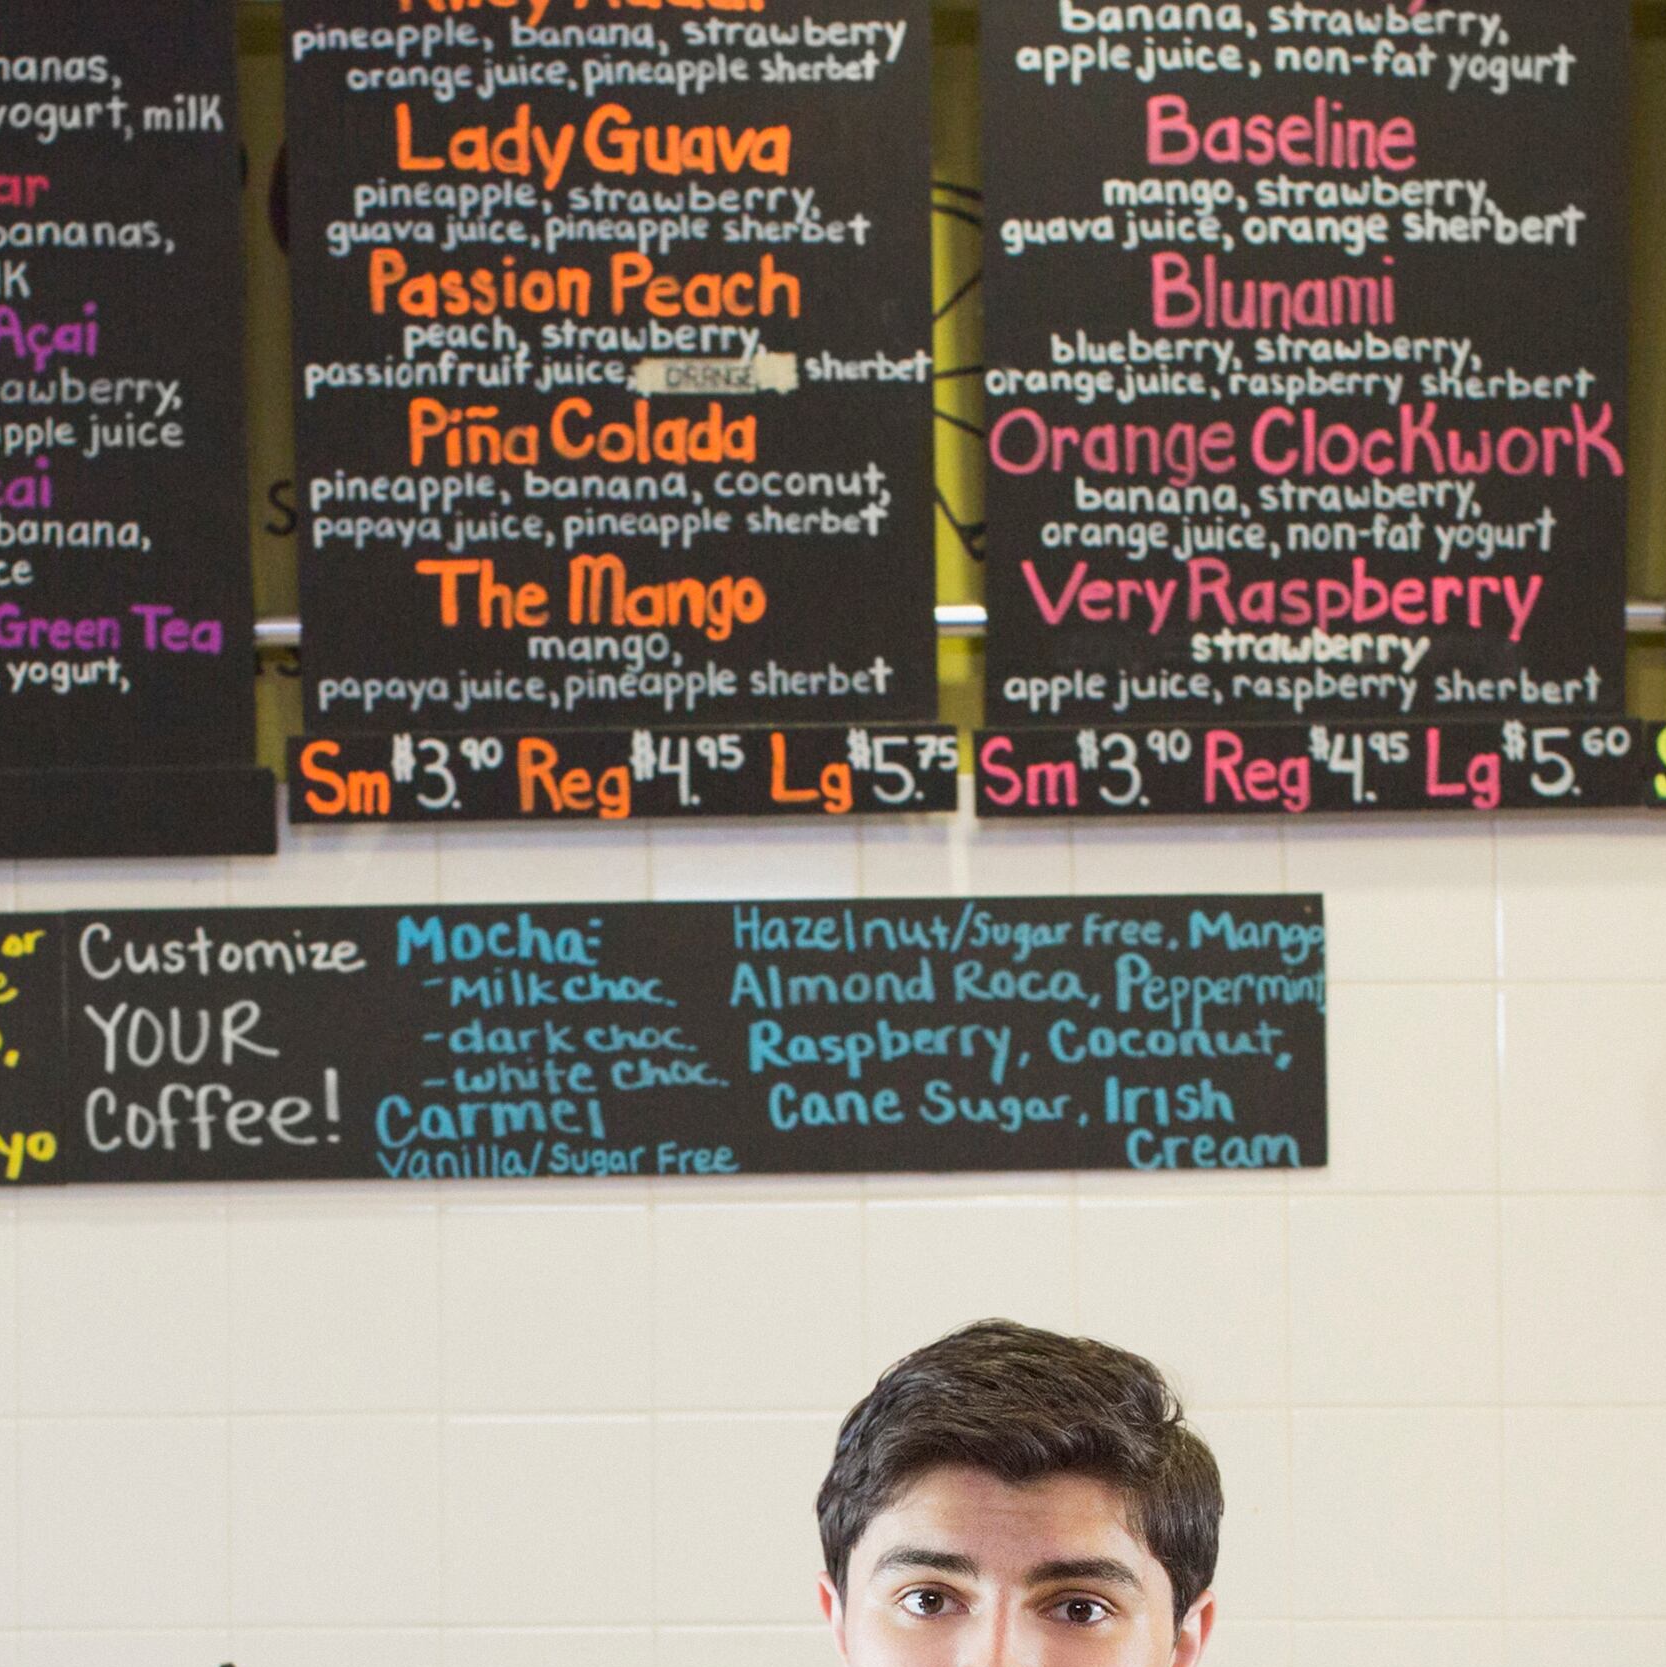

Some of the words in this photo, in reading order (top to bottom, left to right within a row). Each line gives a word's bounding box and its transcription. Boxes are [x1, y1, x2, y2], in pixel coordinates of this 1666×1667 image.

[1274, 37, 1437, 77] non-fat
[1447, 44, 1577, 95] yogurt
[393, 102, 576, 192] Lady
[583, 102, 792, 177] Guava
[1146, 93, 1417, 172] Baseline
[1402, 202, 1586, 246] sherbert
[369, 247, 592, 319] Passion
[610, 249, 801, 319] Peach
[1150, 250, 1395, 332] Blunami
[82, 415, 184, 459] juice
[408, 396, 539, 468] Piña
[550, 396, 757, 465] Colada
[309, 469, 512, 514] pineapple,
[524, 469, 703, 506] banana,
[415, 558, 548, 630] The
[568, 552, 767, 643] Mango
[1020, 559, 1178, 635] Very
[1187, 554, 1543, 644] Raspberry
[129, 603, 223, 654] Tea
[1191, 626, 1431, 674] strawberry
[299, 739, 391, 815] Sm
[517, 736, 631, 821] Reg
[770, 731, 854, 816] Lg
[980, 735, 1079, 807] Sm
[1204, 729, 1311, 814] Reg
[1425, 727, 1501, 812] Lg
[79, 922, 367, 981] Customize
[729, 956, 936, 1010] Almond
[84, 999, 280, 1074] YOUR
[449, 1019, 575, 1054] dark
[453, 1059, 597, 1095] white
[768, 1082, 905, 1131] Cane
[1105, 1075, 1234, 1126] Irish
[85, 1065, 340, 1152] Coffee!
[375, 1094, 605, 1151] Carmel
[1123, 1127, 1304, 1173] Cream
